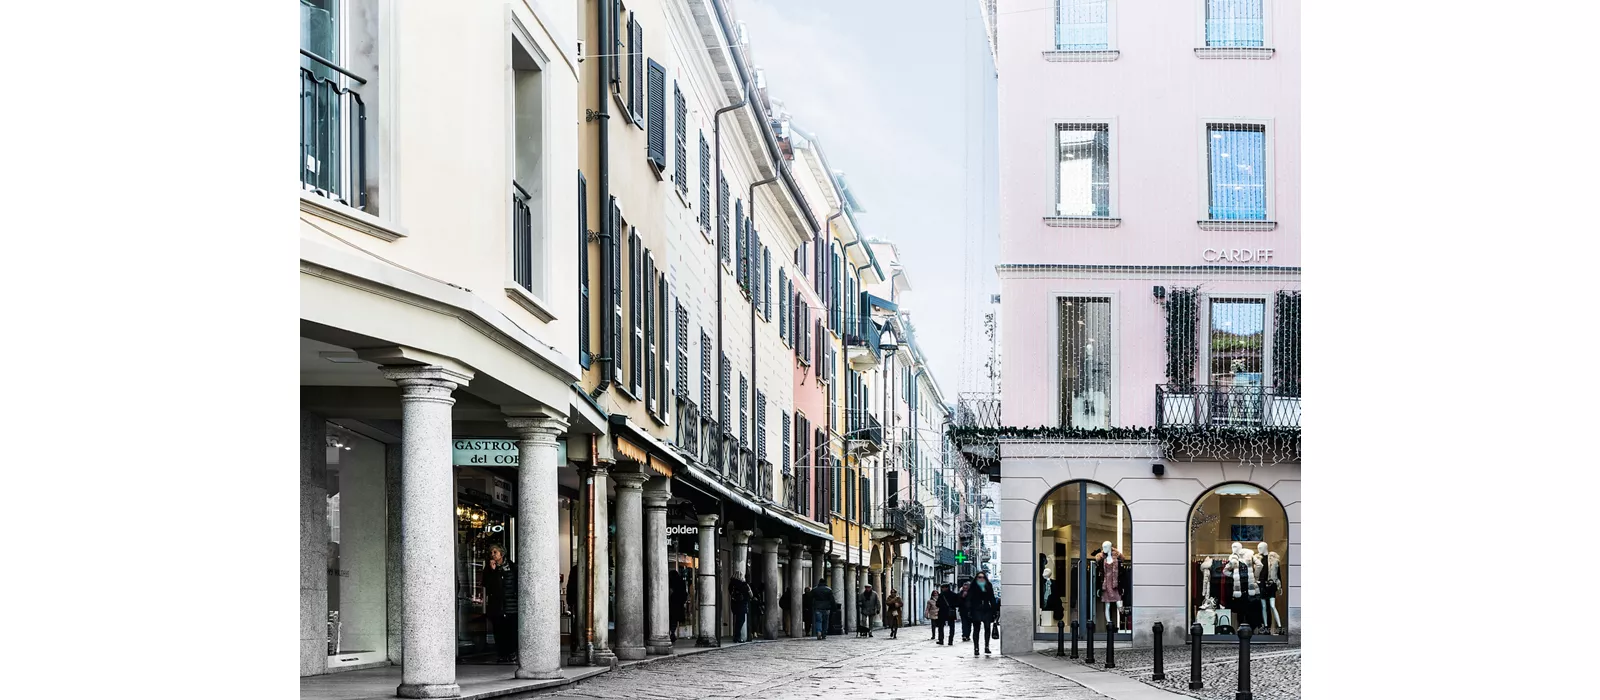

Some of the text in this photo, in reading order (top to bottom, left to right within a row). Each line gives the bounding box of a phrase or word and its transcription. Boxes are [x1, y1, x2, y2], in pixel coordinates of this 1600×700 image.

[1202, 248, 1274, 262] CARDIFF
[454, 440, 520, 451] GASTRON
[470, 454, 487, 464] del
[665, 524, 699, 536] golden
